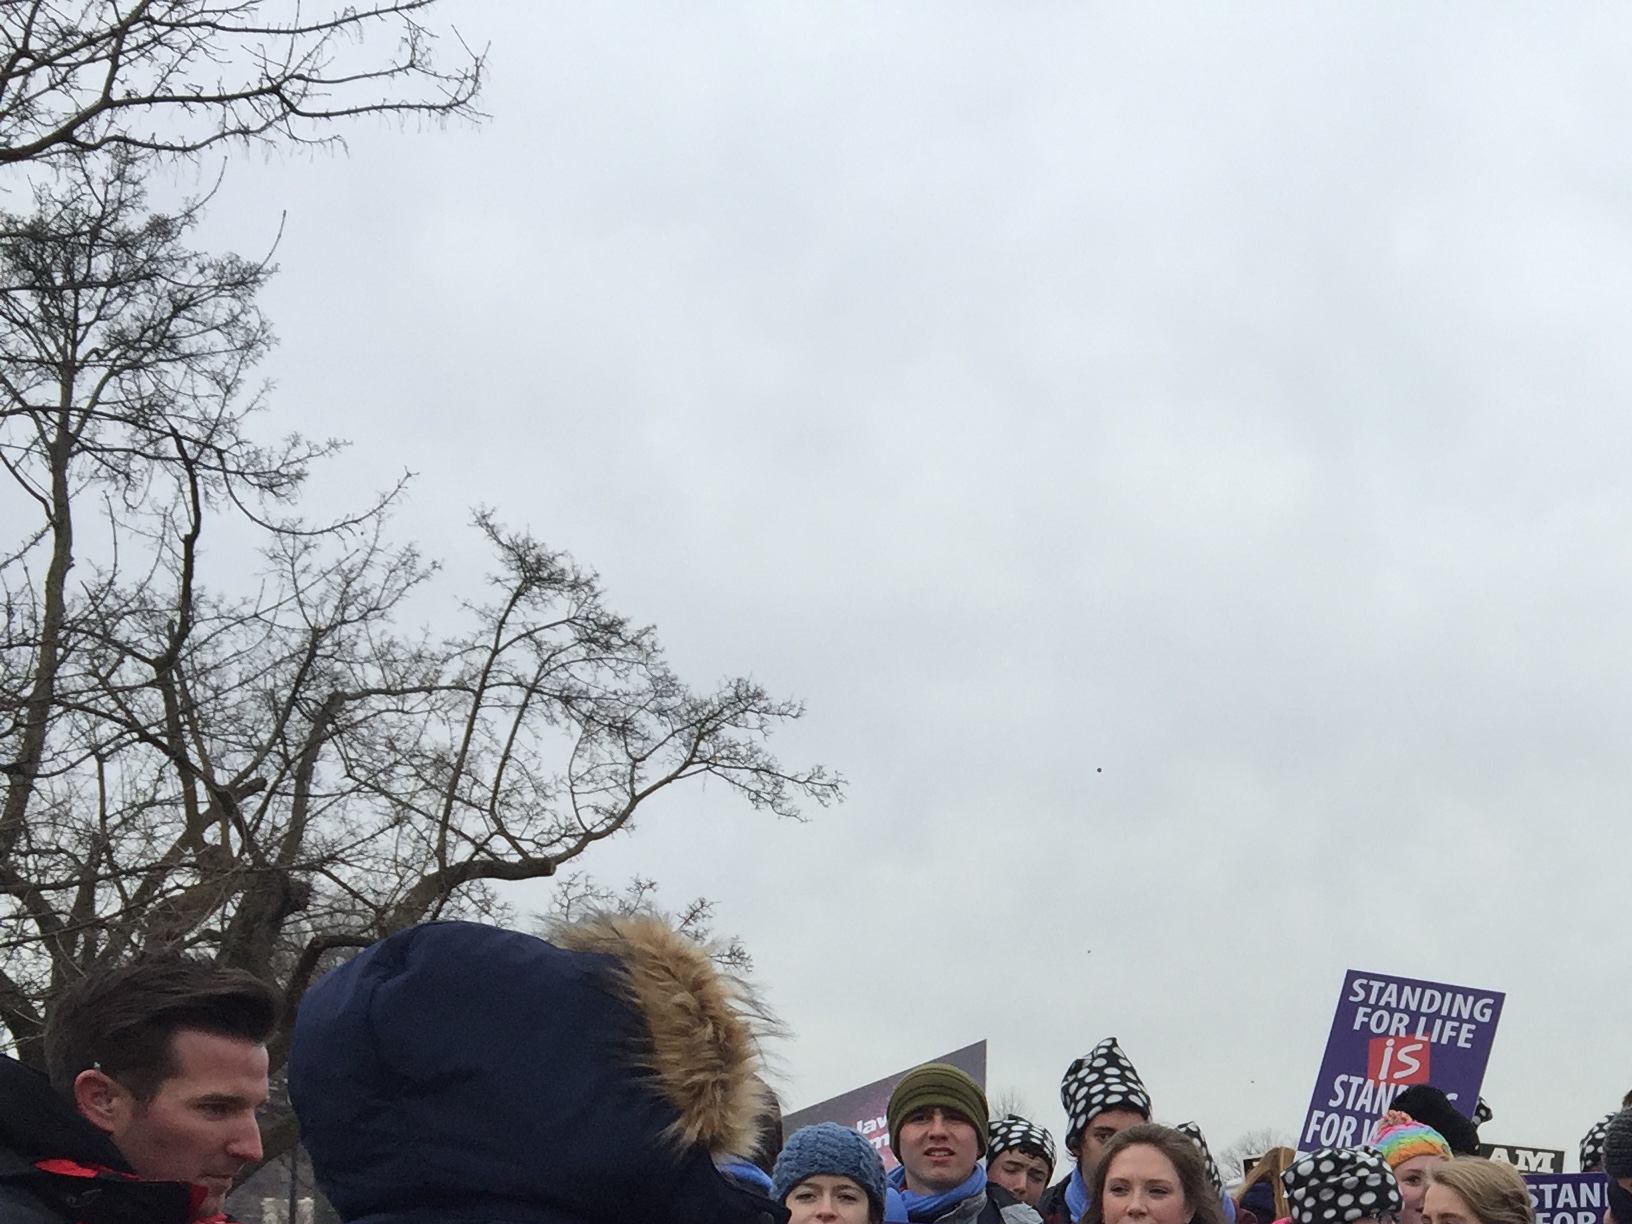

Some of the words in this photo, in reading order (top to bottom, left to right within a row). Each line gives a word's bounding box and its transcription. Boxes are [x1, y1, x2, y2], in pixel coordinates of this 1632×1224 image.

[1349, 978, 1494, 1023] STANDING
[1353, 1006, 1410, 1038] FOR
[1414, 1016, 1476, 1048] LIFE
[1305, 1110, 1357, 1149] FOR
[1489, 1147, 1556, 1173] AM
[1526, 1182, 1609, 1209] STAN
